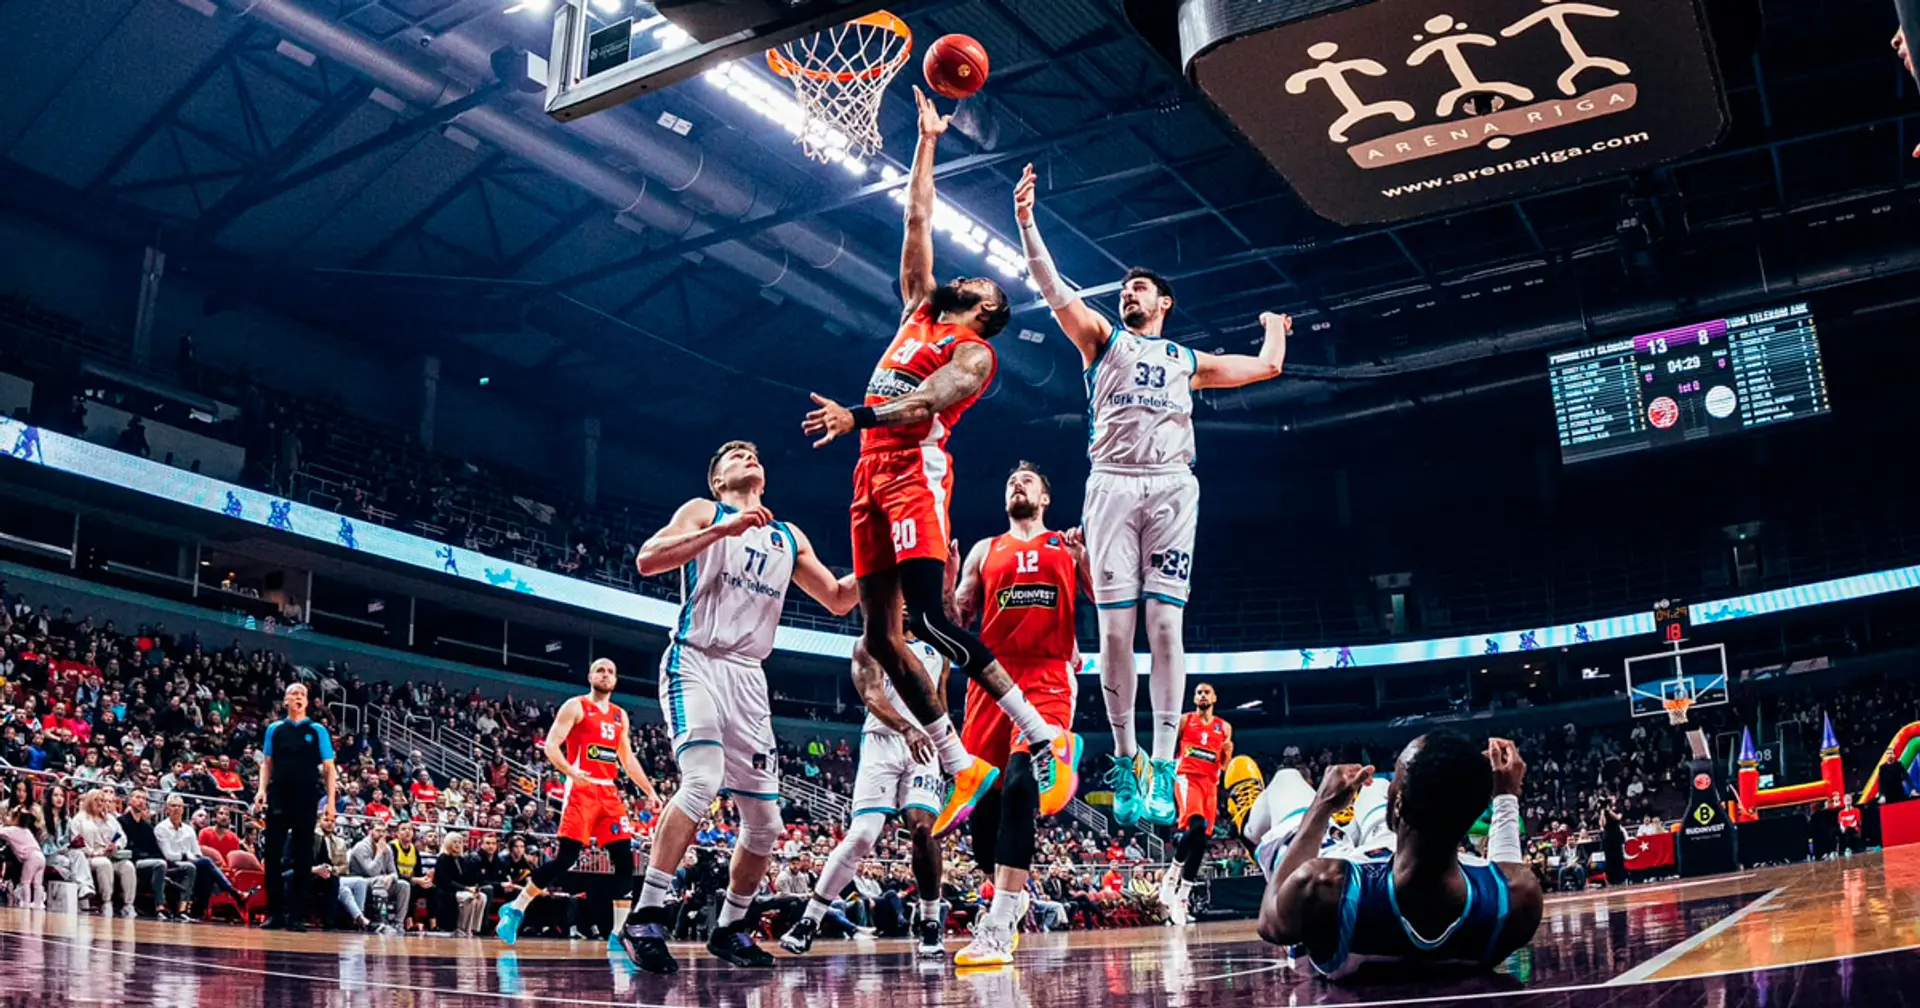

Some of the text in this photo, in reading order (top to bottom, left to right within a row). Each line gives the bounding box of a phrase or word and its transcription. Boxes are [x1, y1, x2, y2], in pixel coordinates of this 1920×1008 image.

[1381, 131, 1649, 198] www.arenariga.com
[1646, 337, 1668, 355] 13
[1697, 330, 1709, 345] 8
[890, 337, 923, 365] 20
[1667, 355, 1701, 373] 04:29
[1135, 361, 1166, 388] 33
[891, 518, 917, 553] 20
[744, 546, 768, 576] 77
[1014, 550, 1039, 573] 12
[1010, 589, 1056, 600] UDINVEST
[1665, 623, 1682, 640] 18
[600, 721, 615, 740] 55
[1699, 806, 1711, 821] B
